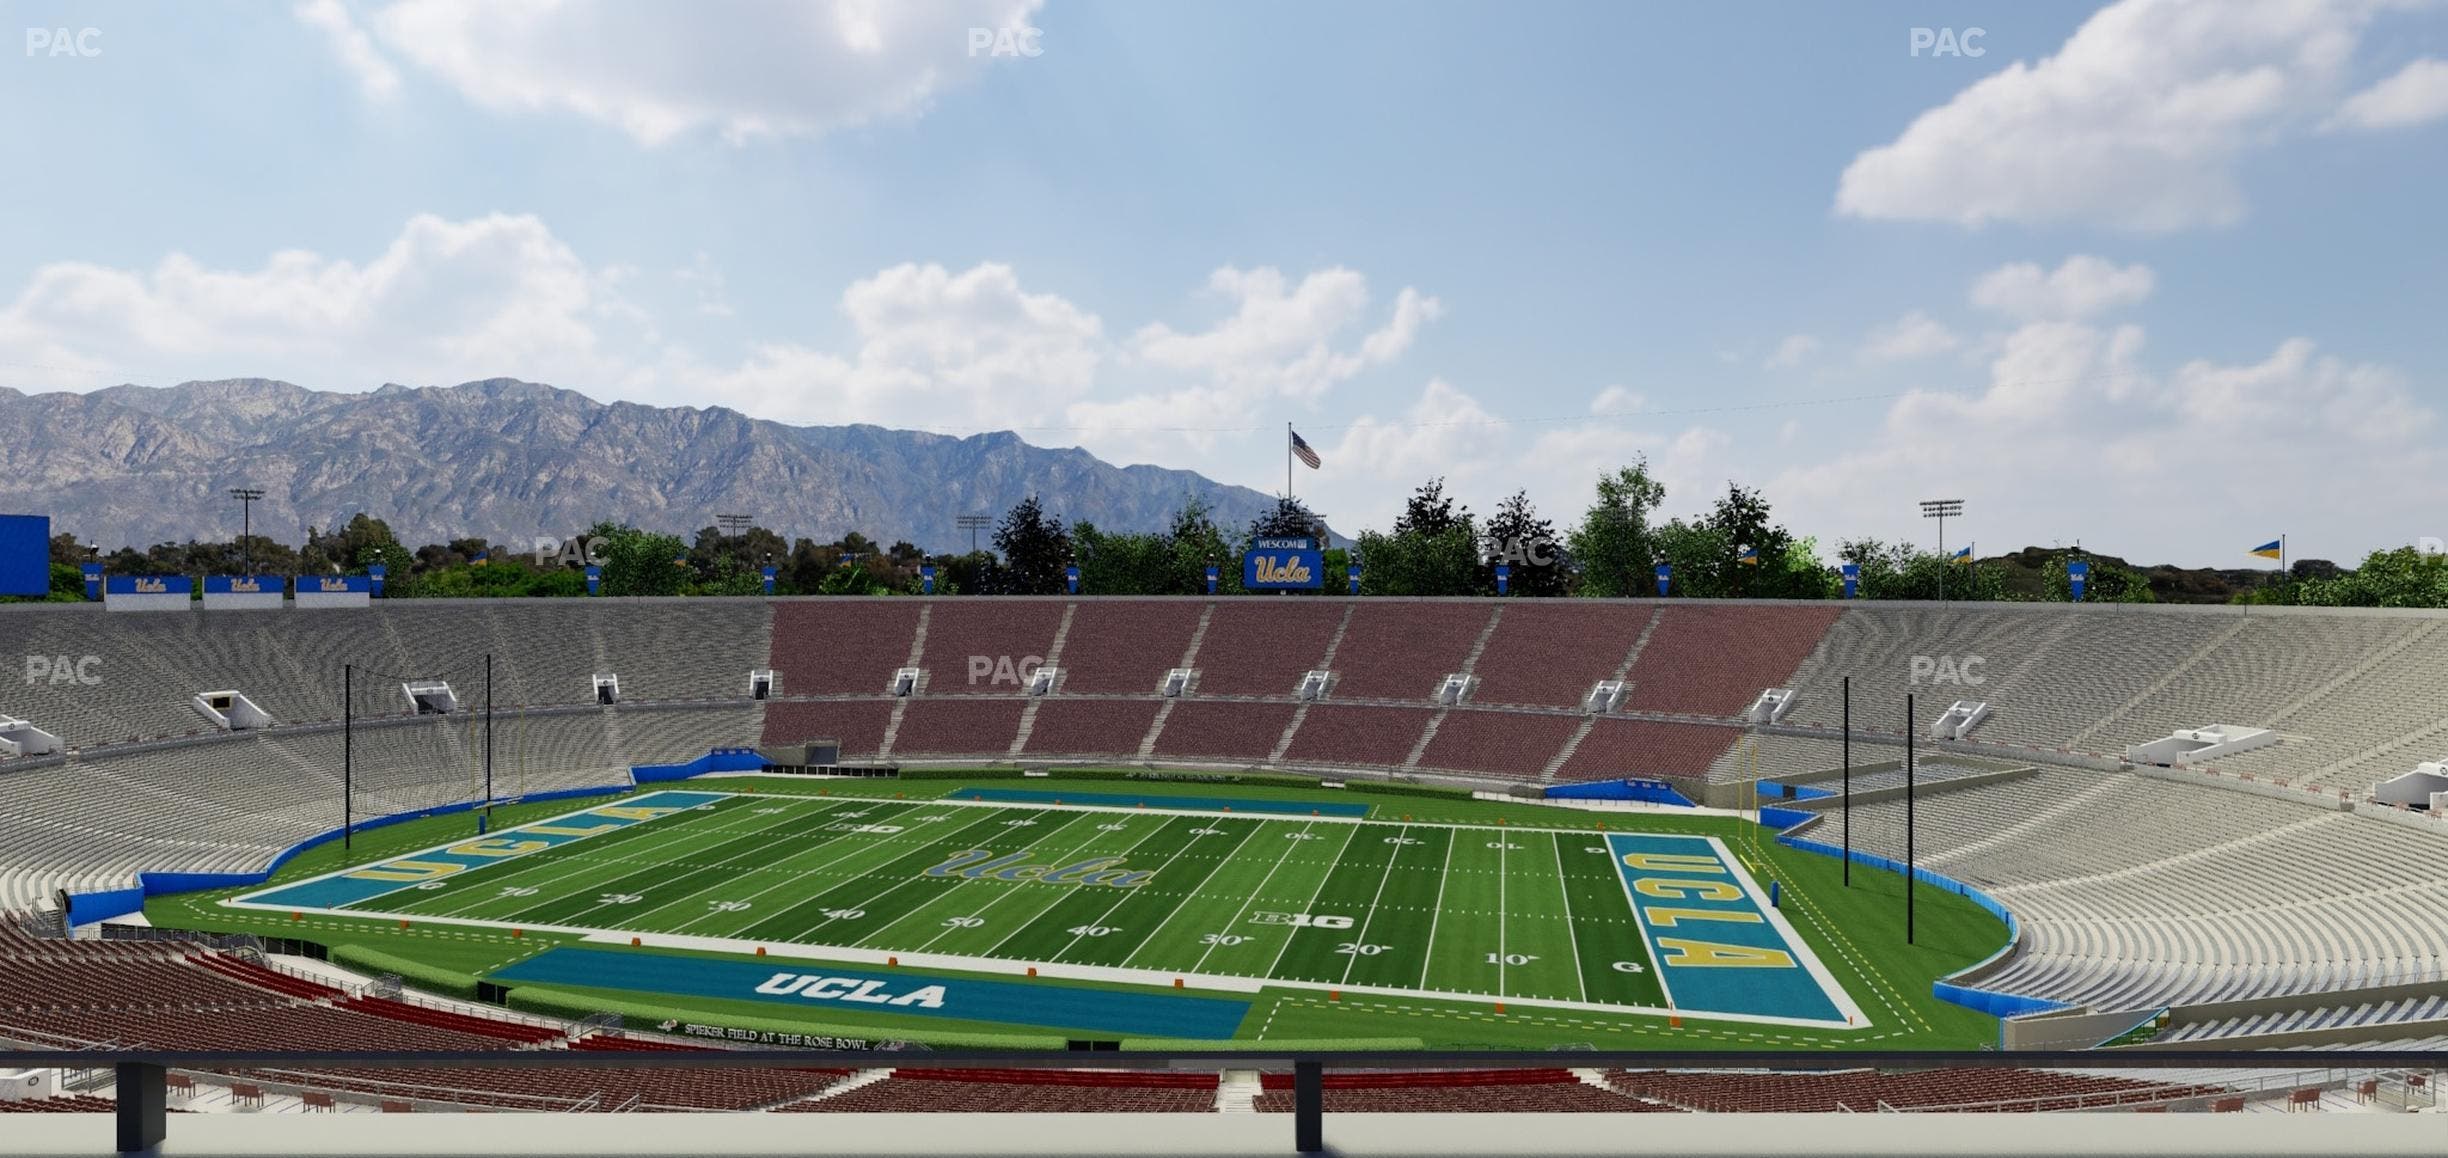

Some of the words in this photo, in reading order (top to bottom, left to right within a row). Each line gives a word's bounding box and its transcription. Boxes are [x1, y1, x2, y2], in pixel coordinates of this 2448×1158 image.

[1258, 539, 1297, 549] WESCOM
[1254, 556, 1312, 583] Ucla
[341, 806, 684, 882] UCLA
[923, 849, 1156, 888] Ucla
[1622, 853, 1798, 968] UCLA
[941, 916, 985, 928] 50
[1066, 924, 1113, 937] 40
[1199, 933, 1245, 946] 30
[1333, 943, 1383, 956] 20
[1484, 952, 1529, 966] 10
[1612, 961, 1645, 973] G
[755, 972, 946, 1008] UCLA
[685, 1023, 725, 1038] SPIEKER
[727, 1028, 758, 1041] FIELD
[759, 1032, 775, 1043] AT
[777, 1033, 801, 1045] THE
[804, 1036, 833, 1048] ROSE
[836, 1038, 868, 1050] BOWL
